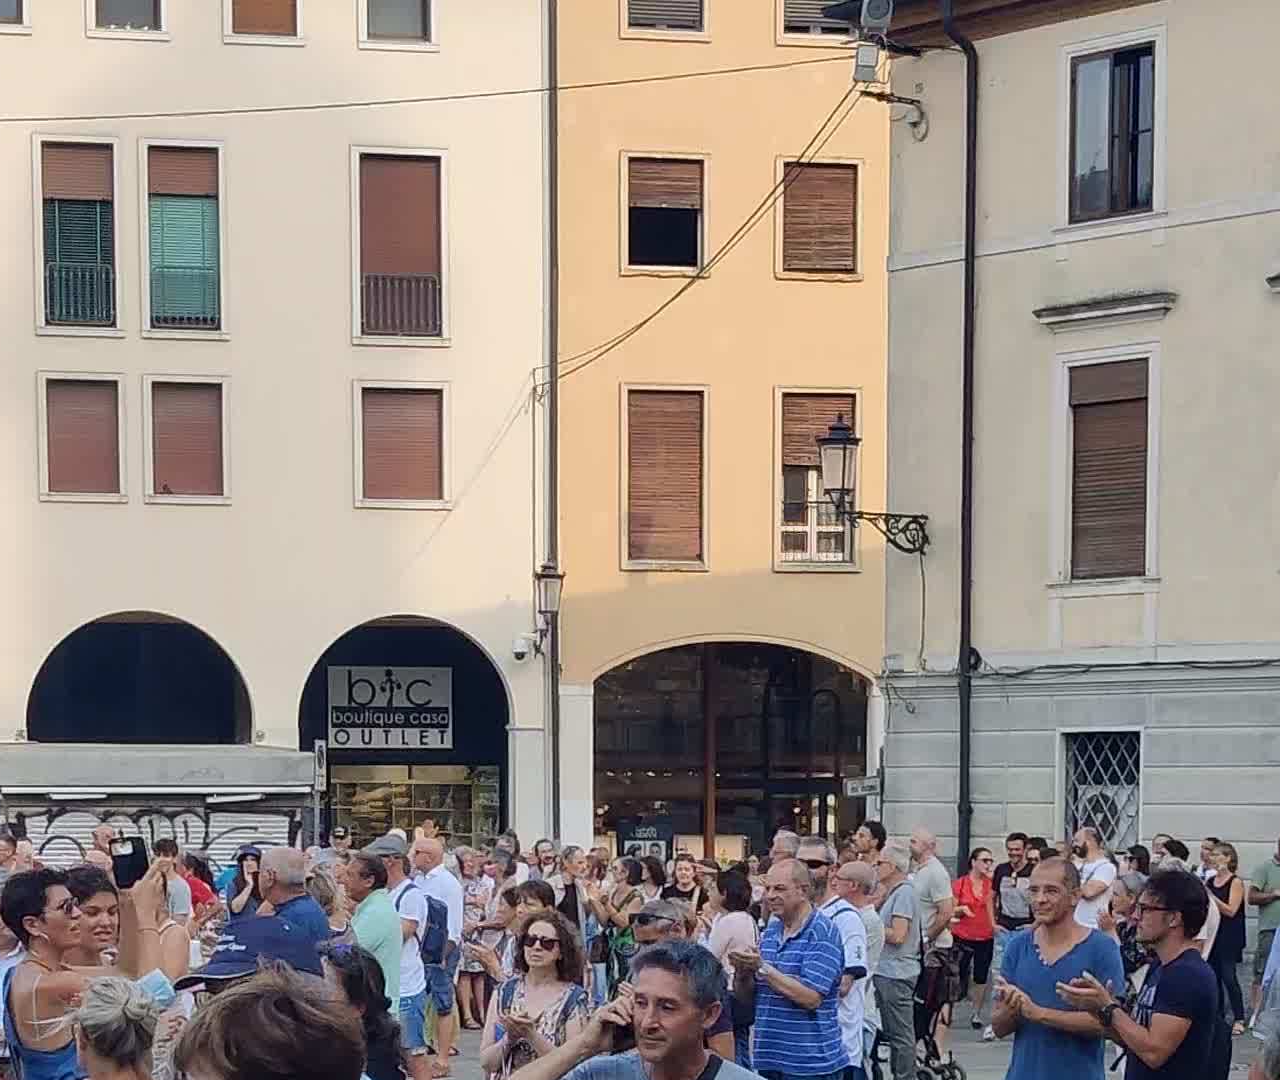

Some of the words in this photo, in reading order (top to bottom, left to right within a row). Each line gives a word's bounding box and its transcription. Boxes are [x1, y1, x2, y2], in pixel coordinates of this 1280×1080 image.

[332, 708, 405, 727] boutique
[409, 712, 449, 724] casa
[334, 728, 448, 745] OUTLET
